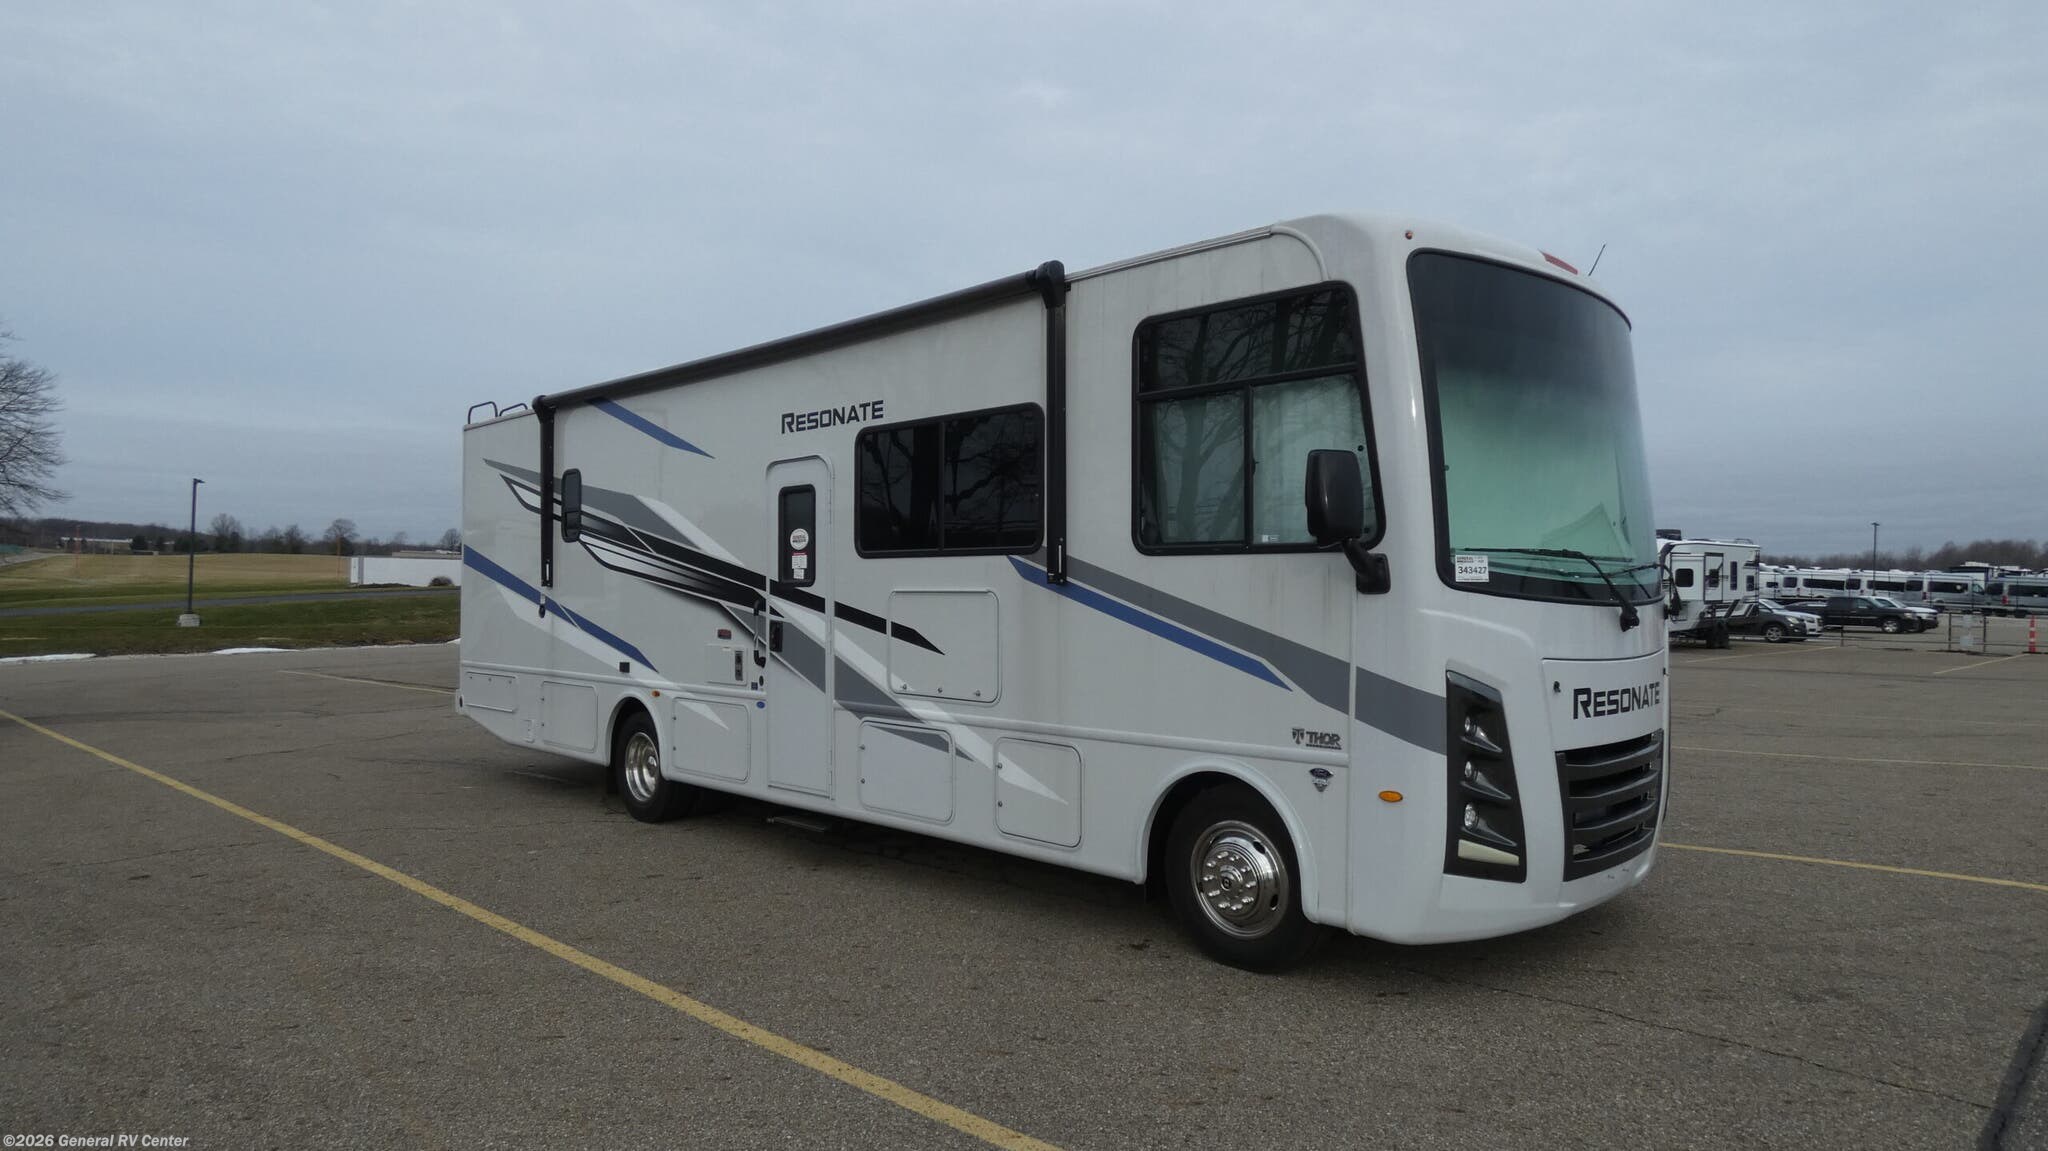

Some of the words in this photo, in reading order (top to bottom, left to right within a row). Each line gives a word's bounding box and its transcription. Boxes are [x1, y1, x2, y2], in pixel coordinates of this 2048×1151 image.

[781, 400, 884, 434] RESONATE
[1458, 566, 1487, 574] 343427
[1573, 681, 1660, 720] RESONATE
[1306, 731, 1341, 746] THOR
